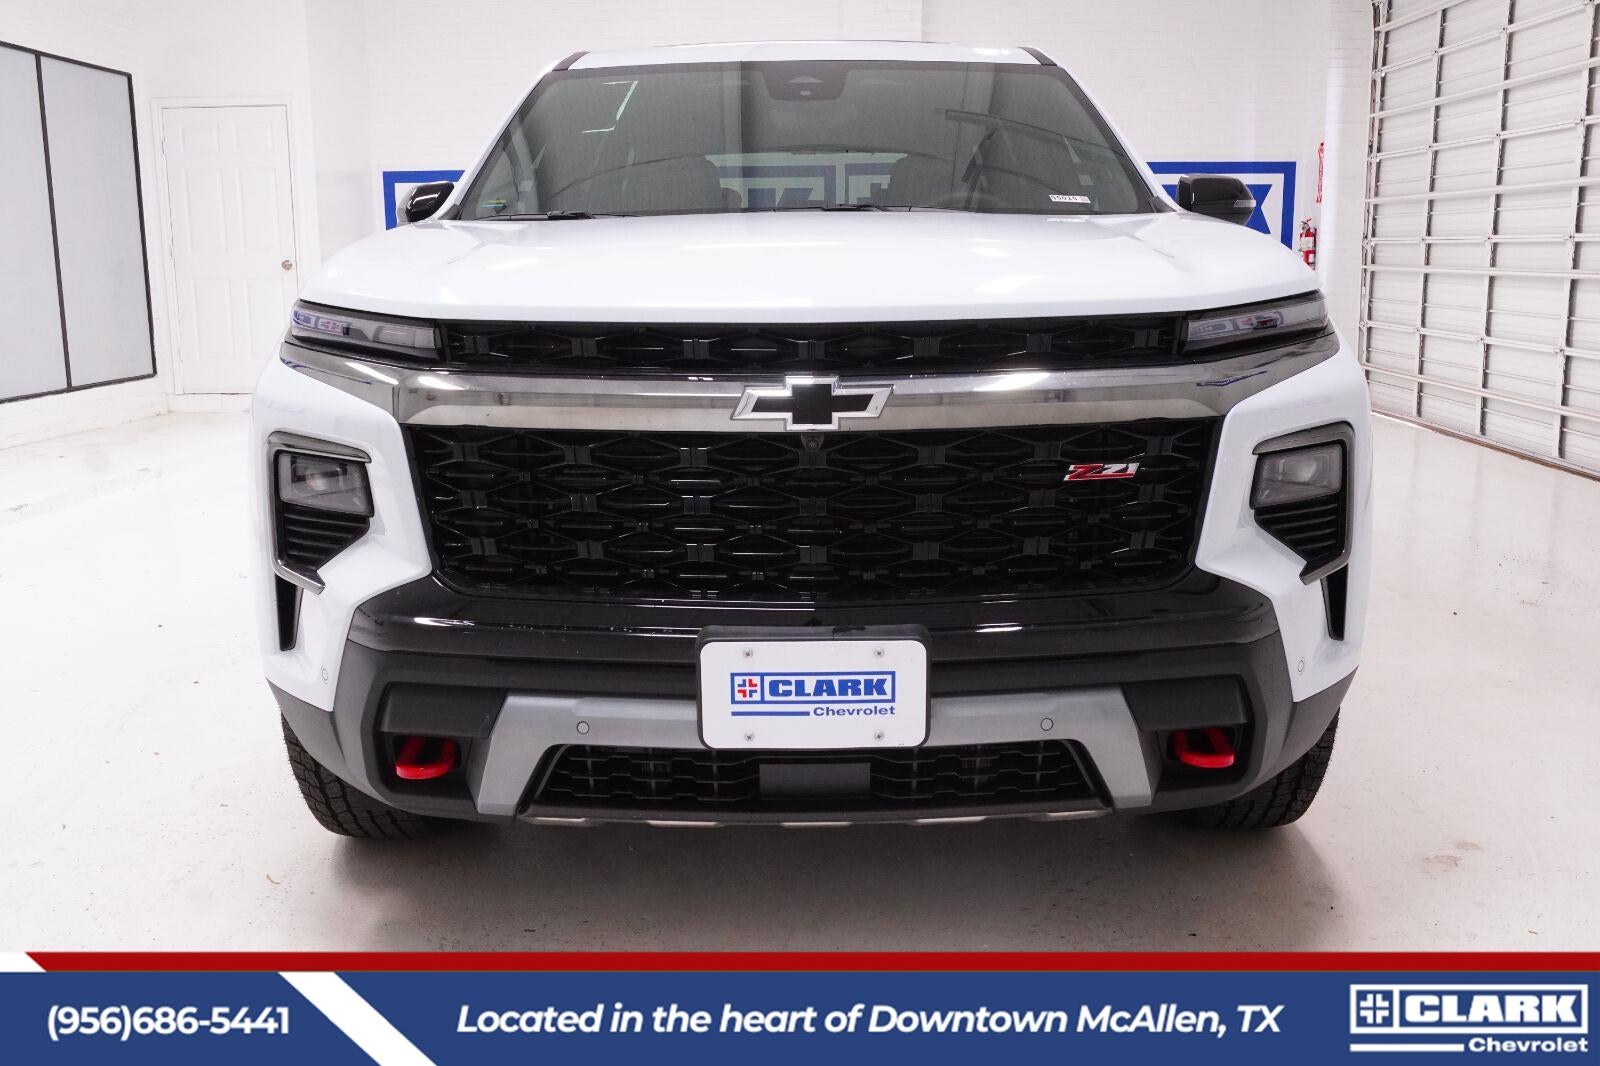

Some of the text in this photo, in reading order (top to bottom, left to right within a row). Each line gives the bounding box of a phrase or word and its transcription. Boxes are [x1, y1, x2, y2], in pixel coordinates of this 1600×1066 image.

[1064, 462, 1140, 481] Z71
[768, 678, 888, 698] CLARK
[813, 705, 896, 716] Chevrolet
